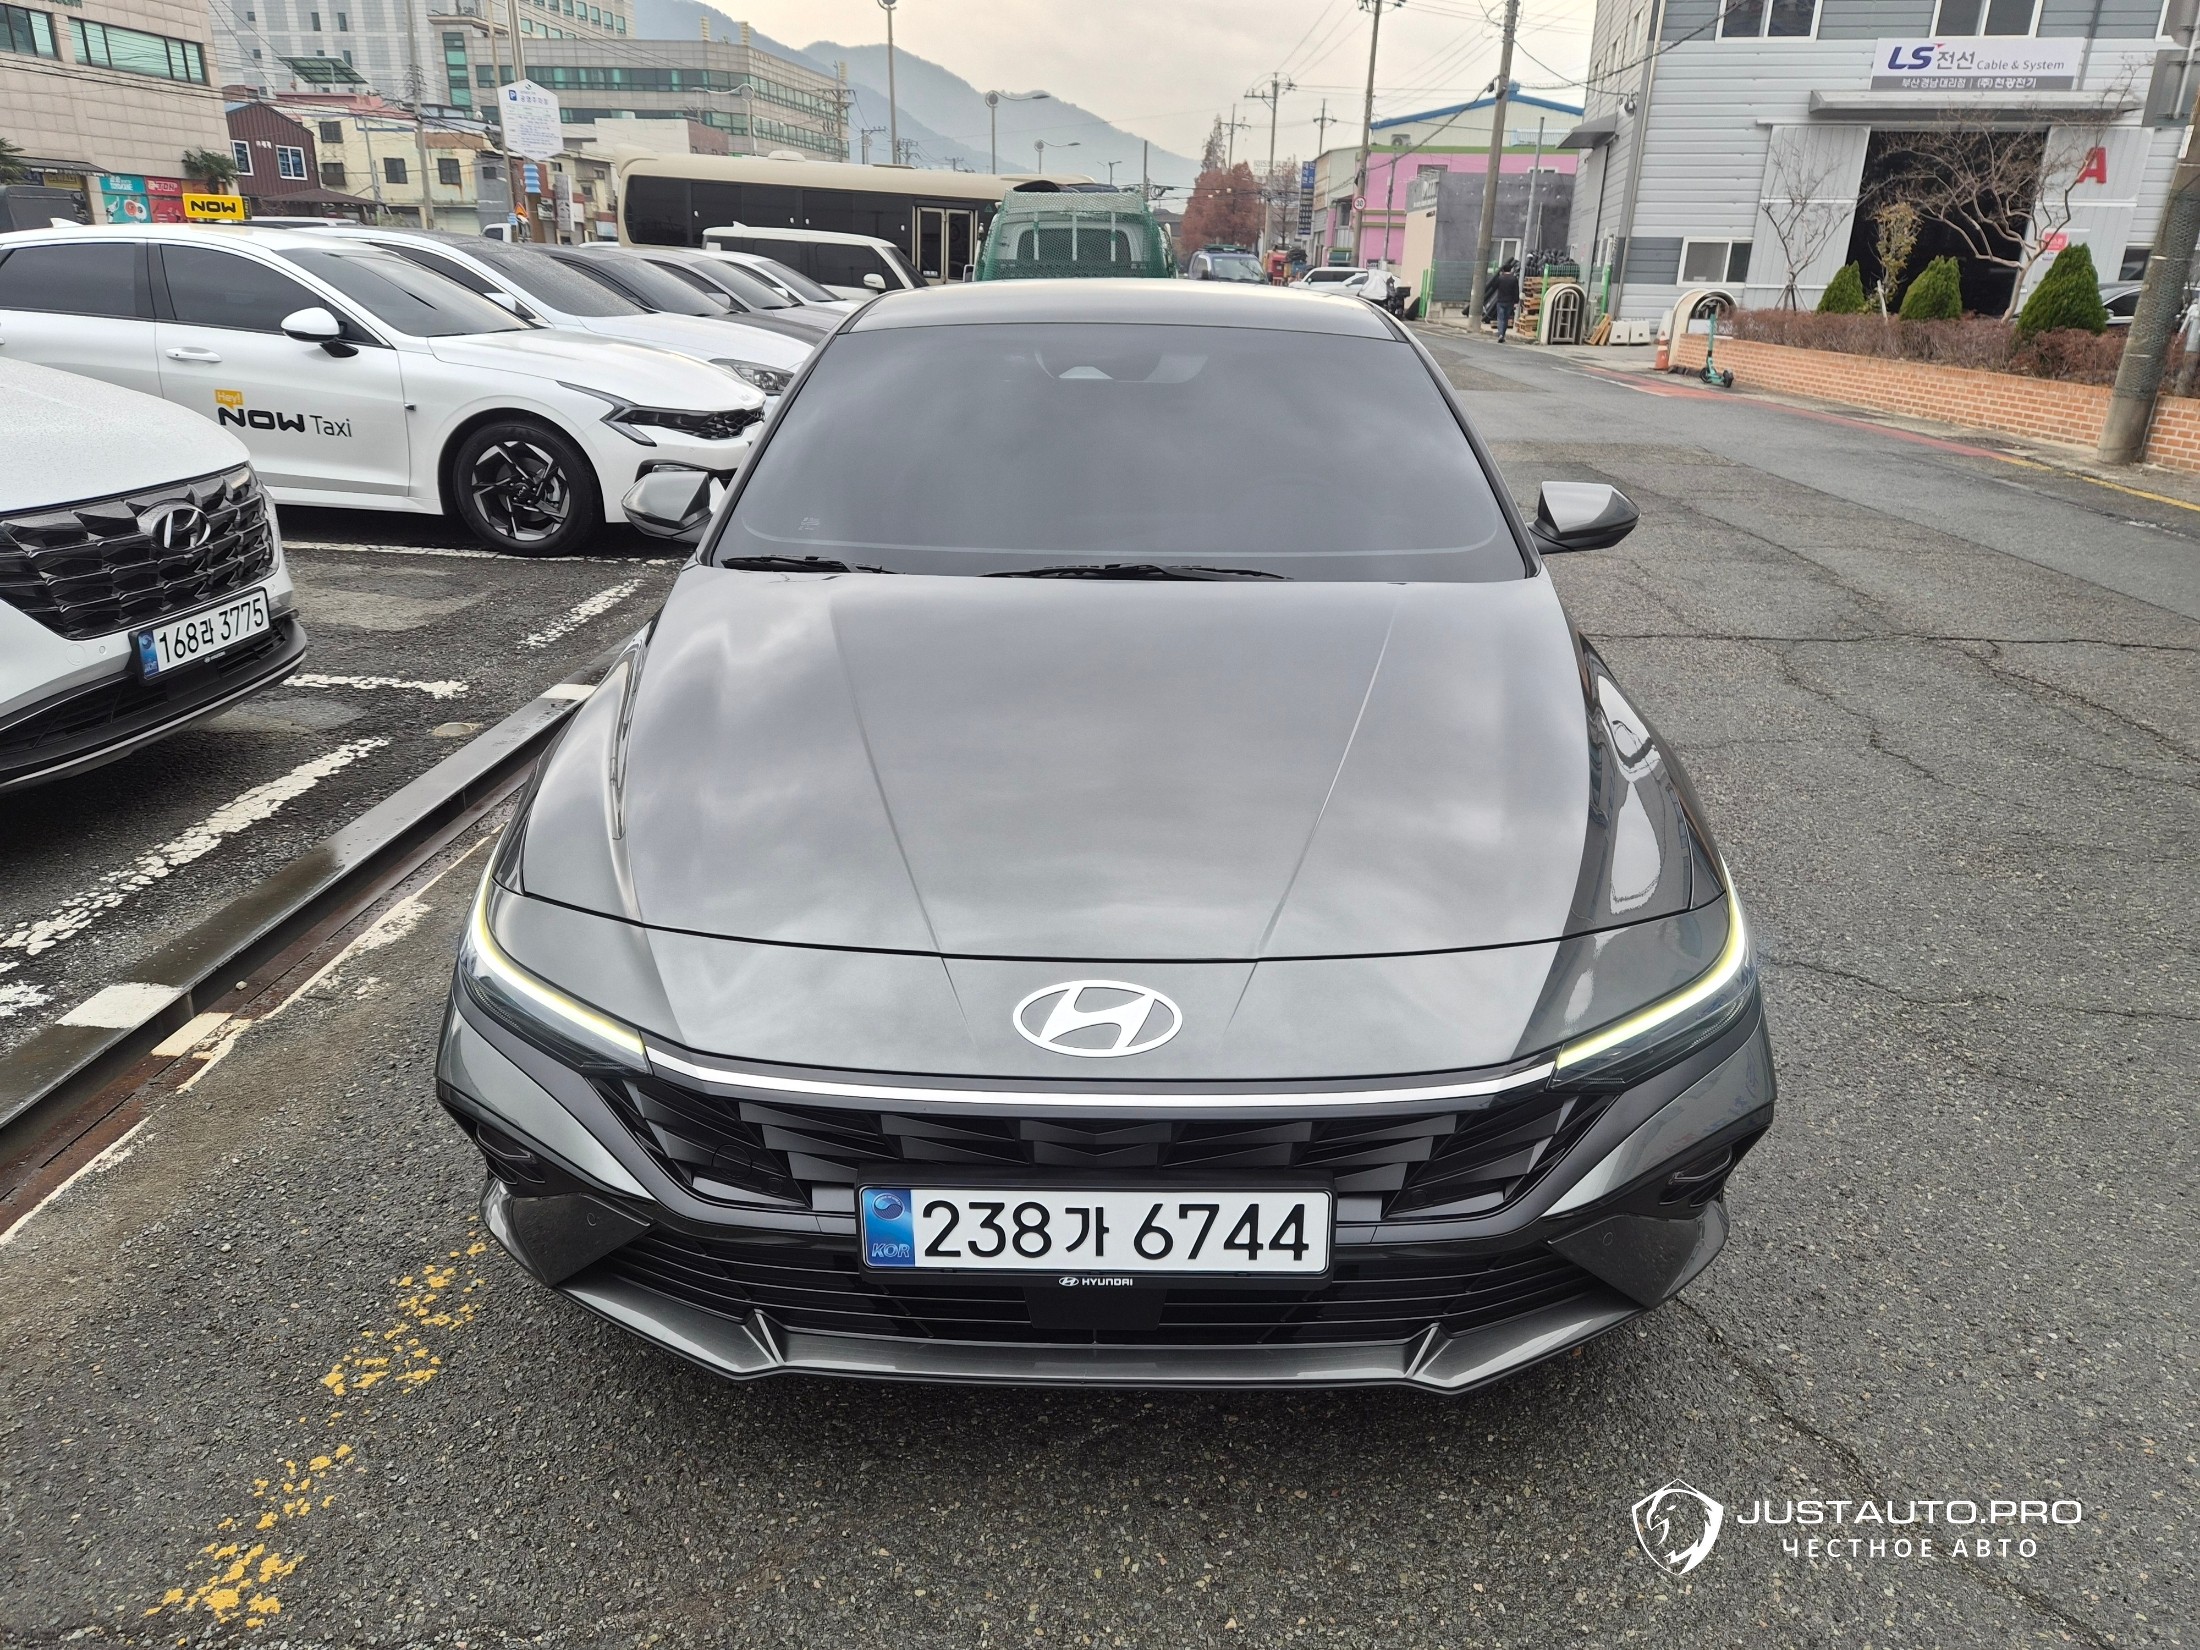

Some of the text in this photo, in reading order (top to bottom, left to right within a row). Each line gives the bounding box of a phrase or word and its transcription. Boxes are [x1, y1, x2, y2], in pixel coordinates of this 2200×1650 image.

[1887, 46, 2065, 72] LS 전선 Cable & System
[2075, 146, 2107, 184] A
[190, 200, 236, 214] NOW
[1355, 199, 1364, 208] 30
[217, 391, 241, 405] Hey!
[217, 406, 353, 438] NOW Taxi
[159, 597, 264, 664] 168라 3775
[922, 1199, 1309, 1262] 238가 6744
[871, 1243, 911, 1258] KOR
[1081, 1277, 1133, 1287] HYUNDAI
